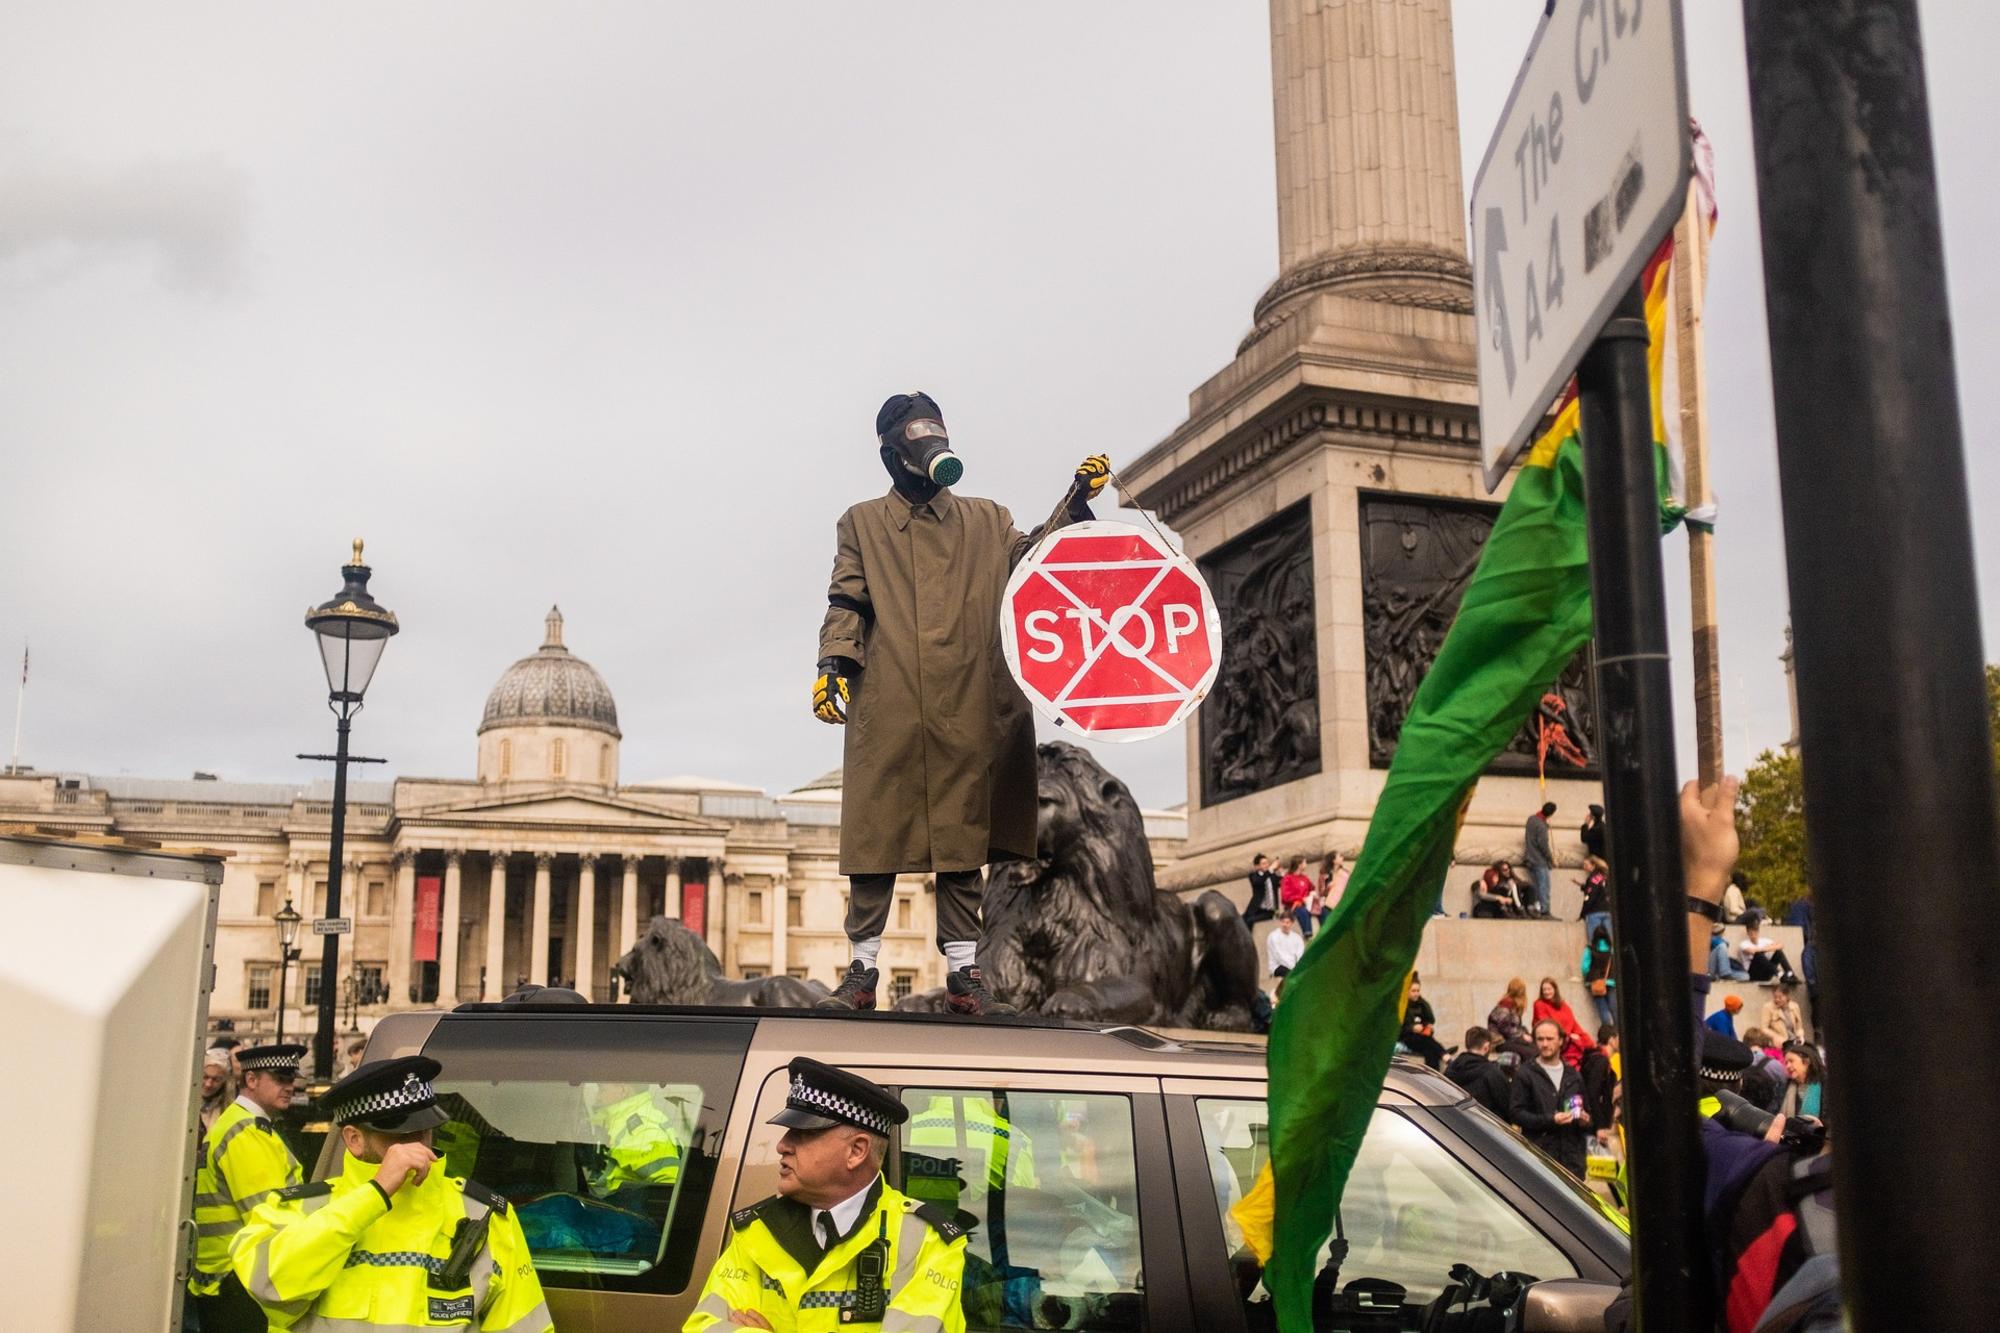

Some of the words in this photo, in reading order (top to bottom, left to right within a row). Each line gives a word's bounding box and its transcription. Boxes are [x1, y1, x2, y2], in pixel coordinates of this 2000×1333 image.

[1515, 91, 1564, 226] The
[1525, 211, 1565, 363] A4
[1024, 603, 1199, 663] STOP
[718, 1267, 750, 1281] OLICE
[430, 1311, 449, 1319] POLICE
